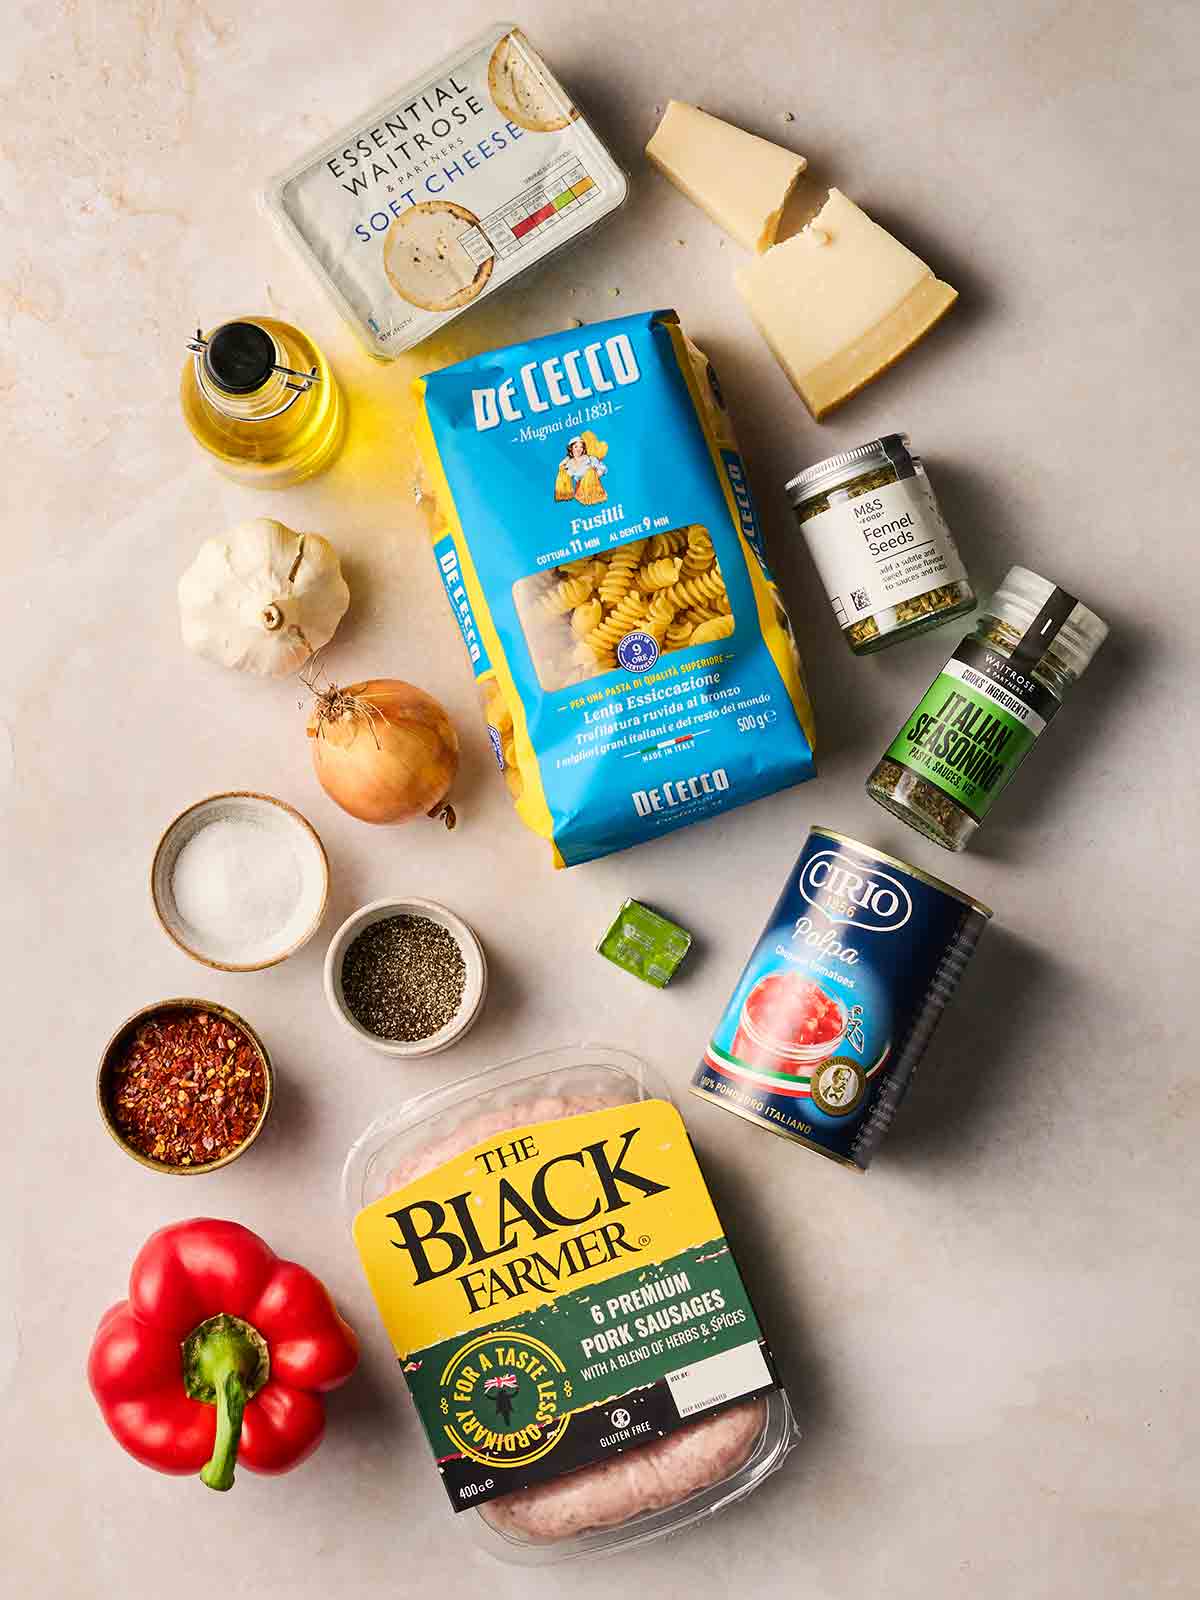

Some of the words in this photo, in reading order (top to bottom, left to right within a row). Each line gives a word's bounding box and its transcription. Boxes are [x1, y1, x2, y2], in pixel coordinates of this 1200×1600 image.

[327, 78, 468, 178] ESSENTIAL
[342, 96, 483, 196] WAITROSE
[355, 189, 416, 242] SOFT
[425, 121, 523, 193] CHEESE
[386, 185, 394, 193] &
[398, 137, 464, 184] PARTNERS
[520, 334, 641, 413] CECCO
[564, 413, 583, 428] dal
[570, 504, 624, 535] Fusilli
[853, 498, 883, 518] M&S
[863, 513, 914, 542] Fennel
[537, 548, 570, 566] COTTURA
[570, 539, 583, 554] 11
[584, 537, 601, 549] MIN
[609, 532, 619, 542] AL
[620, 524, 643, 538] DENTE
[643, 516, 651, 530] 9
[653, 516, 670, 528] MIN
[869, 531, 914, 556] Seeds
[880, 562, 893, 576] add
[901, 552, 923, 567] subtle
[923, 548, 936, 560] and
[883, 571, 903, 583] sweet
[905, 562, 922, 574] anise
[923, 555, 943, 569] flavour
[885, 582, 894, 591] to
[895, 573, 920, 588] sauces
[921, 567, 934, 578] and
[440, 549, 459, 589] DE
[453, 586, 481, 663] CECCO
[631, 653, 649, 664] ORE
[632, 643, 642, 656] 9
[570, 697, 586, 711] PER
[586, 691, 604, 704] UNA
[605, 682, 632, 697] PASTA
[633, 679, 643, 689] DI
[644, 666, 679, 685] QUALITÀ
[680, 655, 725, 674] SUPERIORE
[961, 669, 988, 689] COOKS'
[985, 684, 1029, 720] INGREDIENTS
[985, 655, 1036, 693] WAITROSE
[992, 671, 1024, 695] PARTNERS
[576, 716, 641, 745] Trafilatura
[643, 702, 684, 723] ruvida
[687, 696, 698, 709] al
[700, 686, 741, 705] bronzo
[584, 703, 624, 724] Lenta
[626, 672, 720, 710] Essiccazione
[600, 736, 627, 755] grani
[629, 724, 666, 745] italiani
[667, 723, 674, 732] e
[676, 715, 691, 729] del
[694, 709, 720, 723] resto
[721, 704, 736, 716] del
[737, 694, 771, 710] mondo
[736, 714, 756, 733] 500
[936, 691, 1014, 757] ITALIAN
[642, 751, 663, 763] MADE
[663, 747, 673, 756] IN
[674, 741, 696, 753] ITALY
[632, 788, 664, 817] DE
[663, 768, 730, 807] CECCO
[932, 761, 961, 789] SAUCES,
[809, 861, 899, 917] CIRIO
[792, 917, 860, 965] Polpa
[715, 1082, 763, 1112] POMOORO
[765, 1105, 812, 1135] ITALIANO
[474, 1135, 540, 1175] THE
[385, 1127, 671, 1287] BLACK
[456, 1221, 642, 1315] FARMER
[590, 1304, 605, 1325] 6
[606, 1271, 692, 1319] PREMIUM
[580, 1323, 634, 1359] PORK
[634, 1288, 726, 1338] SAUSAGES
[580, 1362, 609, 1381] WITH
[608, 1358, 619, 1372] A
[617, 1345, 651, 1369] BLEND
[651, 1339, 665, 1355] OF
[665, 1327, 699, 1350] HERBS
[701, 1323, 710, 1336] &
[710, 1308, 747, 1333] SPICES
[454, 1366, 481, 1401] FOR
[478, 1353, 493, 1371] A
[495, 1347, 547, 1381] TASTE
[670, 1374, 681, 1383] USE
[535, 1380, 557, 1425] LESS
[455, 1409, 542, 1452] ORDINARY
[600, 1429, 630, 1448] GLUTEN
[631, 1420, 652, 1436] FREE
